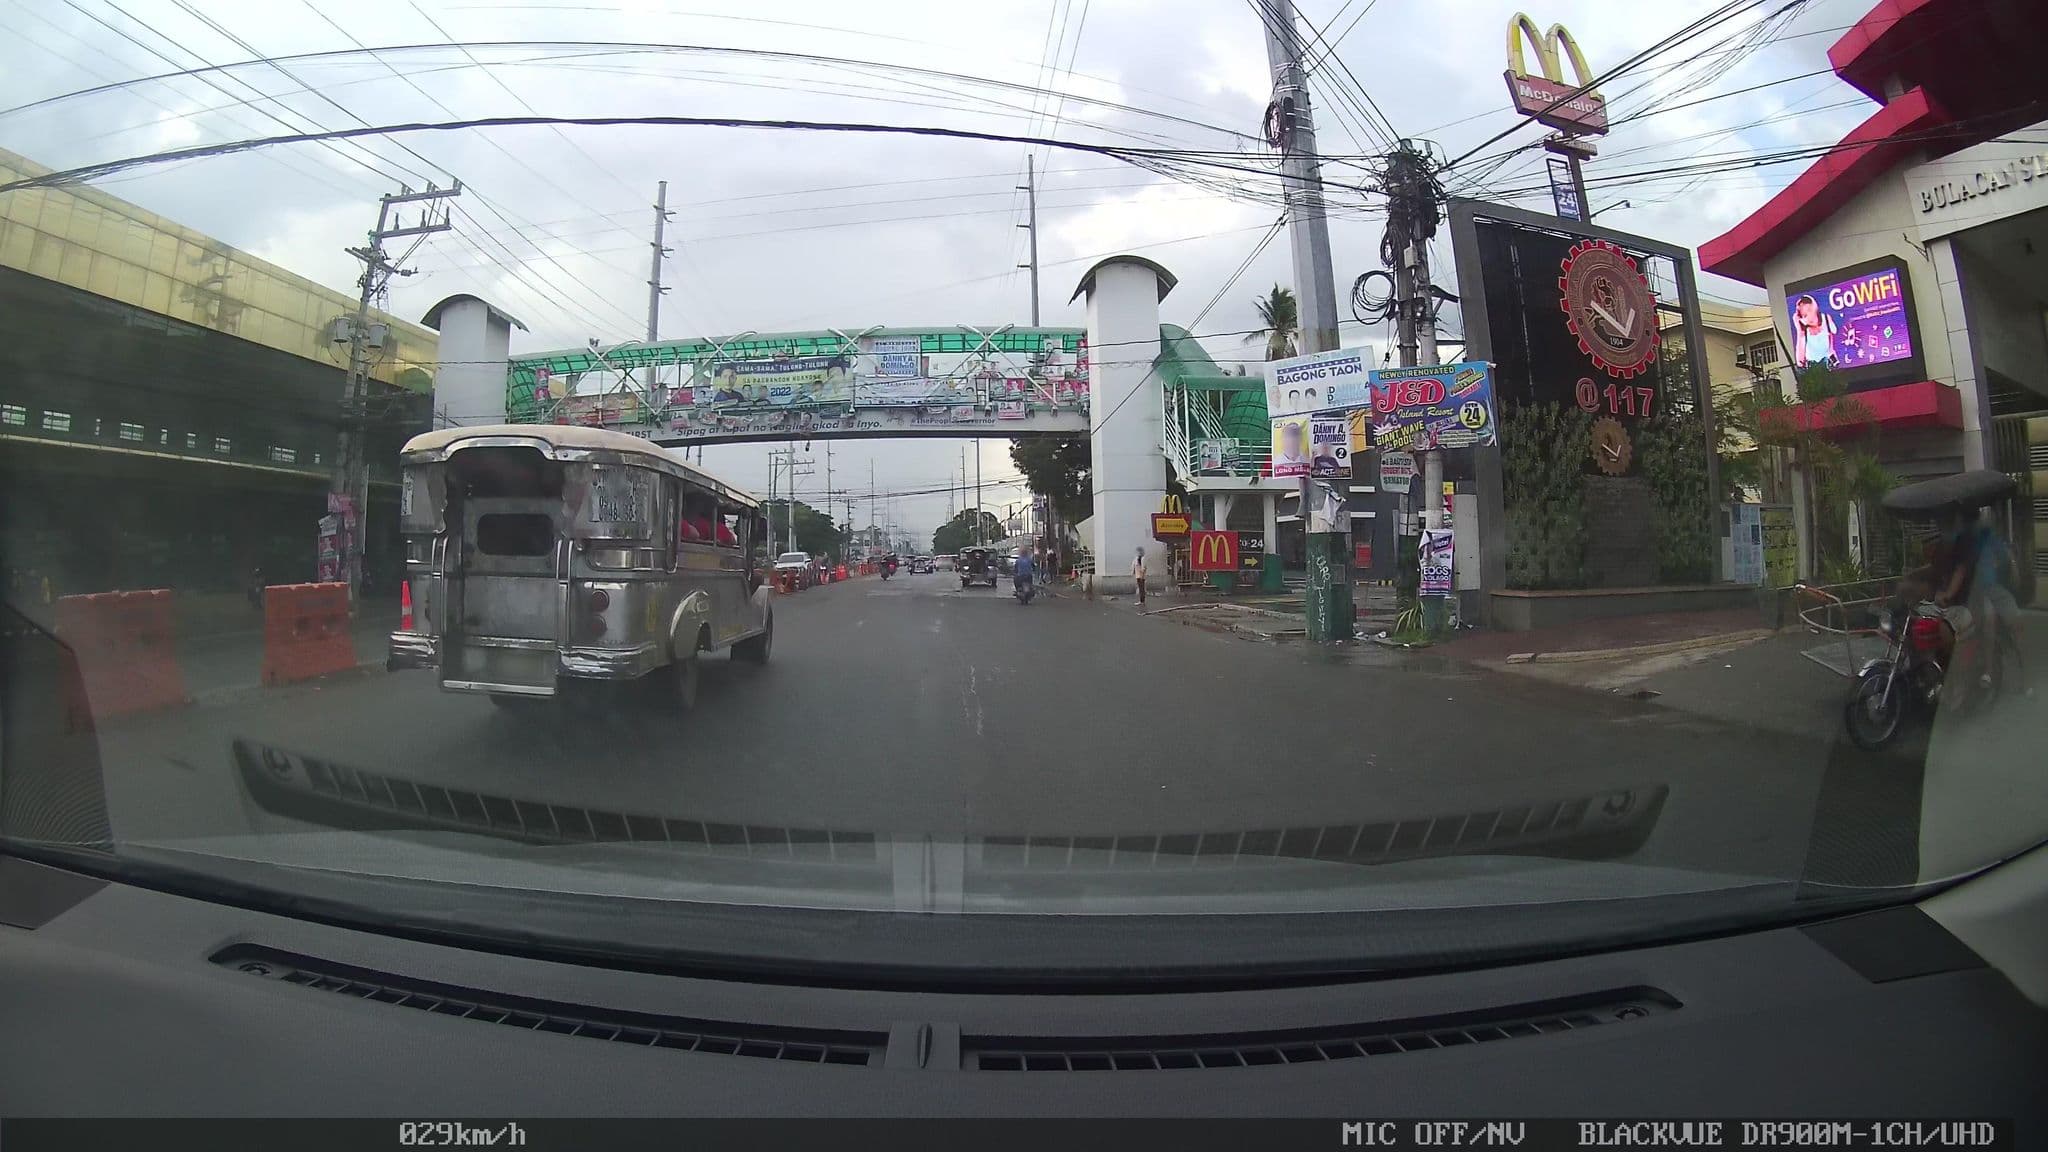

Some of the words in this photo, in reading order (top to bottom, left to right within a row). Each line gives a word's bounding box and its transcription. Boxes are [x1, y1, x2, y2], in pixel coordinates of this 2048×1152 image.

[1921, 162, 2018, 214] BULACAN
[1828, 273, 1898, 310] GoWiFi
[1277, 368, 1327, 386] BAGONG
[1328, 363, 1362, 377] TAON
[1379, 371, 1406, 380] NEWLY
[1407, 366, 1455, 377] RENOVATED
[770, 387, 792, 397] 2022
[1575, 377, 1653, 417] @117
[1397, 408, 1424, 418] Island
[1427, 406, 1454, 418] Resort
[1464, 408, 1481, 422] 24
[677, 428, 706, 436] Sipag
[857, 420, 883, 429] inyo.
[1313, 423, 1336, 434] DANNY
[1337, 423, 1346, 434] A.
[1376, 430, 1400, 446] GIANT
[1401, 420, 1425, 438] WAVE
[1313, 434, 1346, 444] DOMINGO
